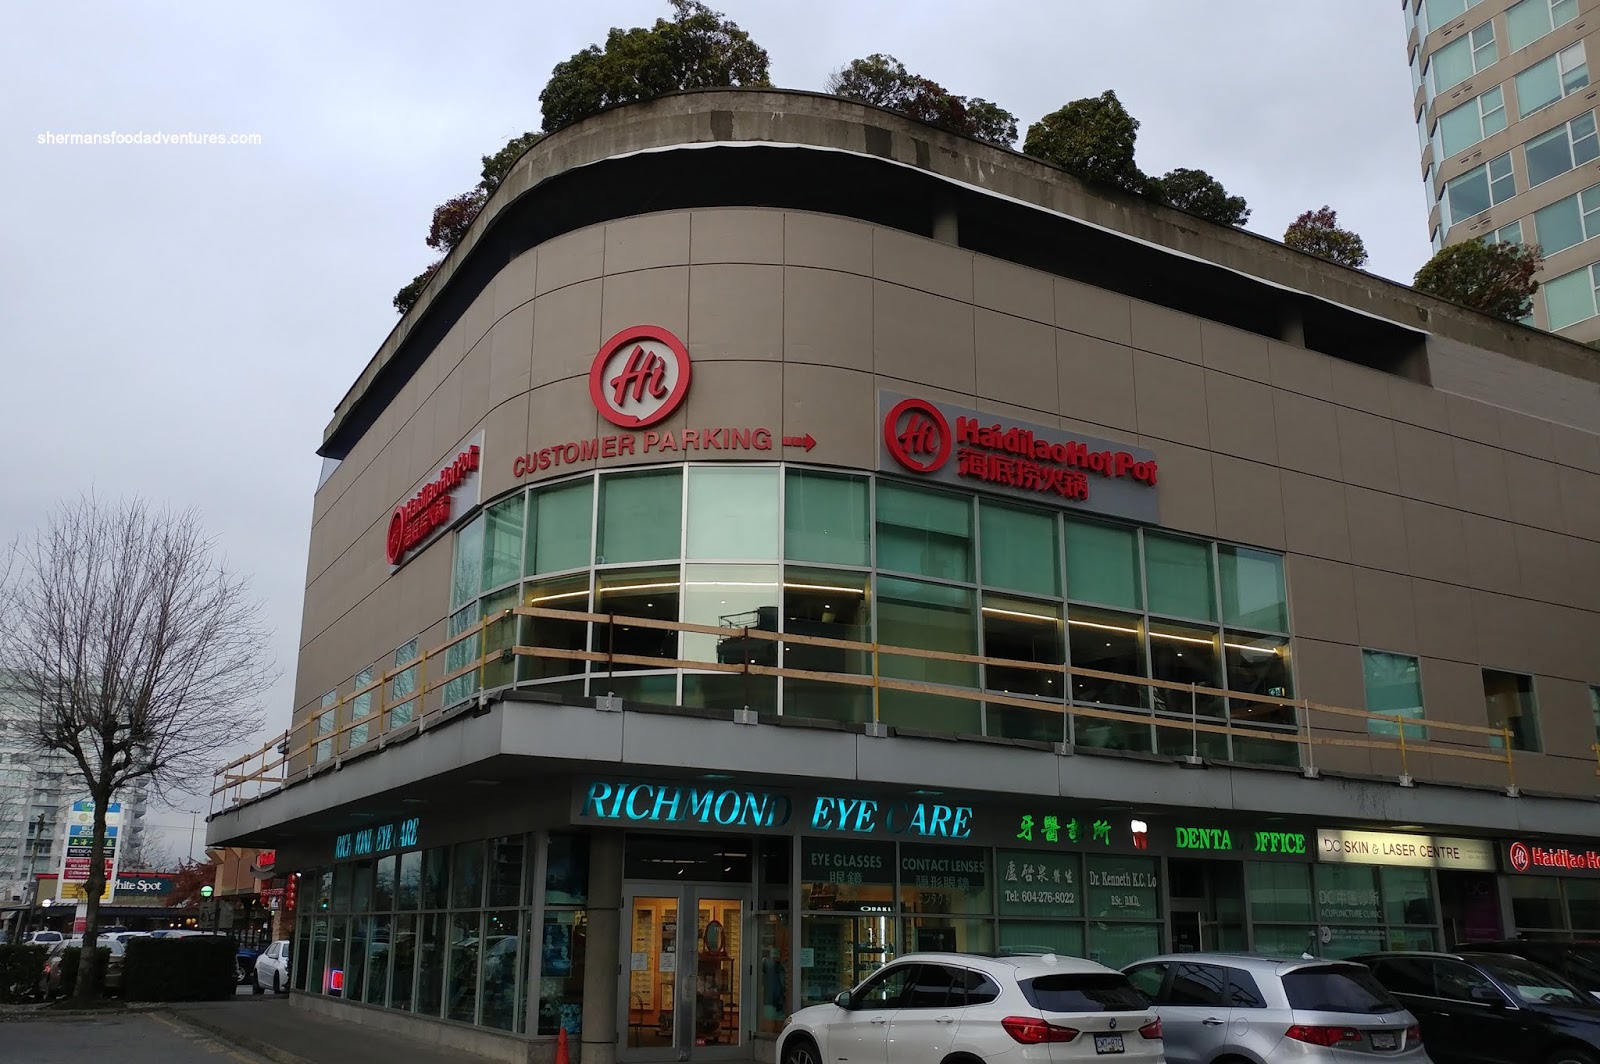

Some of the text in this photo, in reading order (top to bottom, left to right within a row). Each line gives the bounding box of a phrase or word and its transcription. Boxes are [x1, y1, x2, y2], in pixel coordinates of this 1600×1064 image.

[512, 428, 773, 478] CUSTOMER PARKING
[579, 781, 793, 828] RICHMOND
[810, 796, 878, 833] EYE
[1174, 826, 1306, 853] DENTA OFFICE
[1324, 837, 1341, 853] DC
[1344, 840, 1369, 854] SKIN
[1372, 843, 1379, 855] &
[1383, 843, 1416, 857] LASER
[1419, 845, 1460, 859] CENTRE
[811, 853, 882, 869] EYE GLASSES
[901, 857, 985, 873] CONTACT LENSES
[1532, 847, 1586, 869] Haidilao
[115, 879, 162, 892] hite Spot
[829, 871, 863, 885] 眼鏡
[1089, 871, 1100, 886] Dr.
[1101, 872, 1131, 886] Kenneth
[1021, 890, 1075, 904] 604-276-8022
[1321, 909, 1363, 918] ACUPUNCTURE
